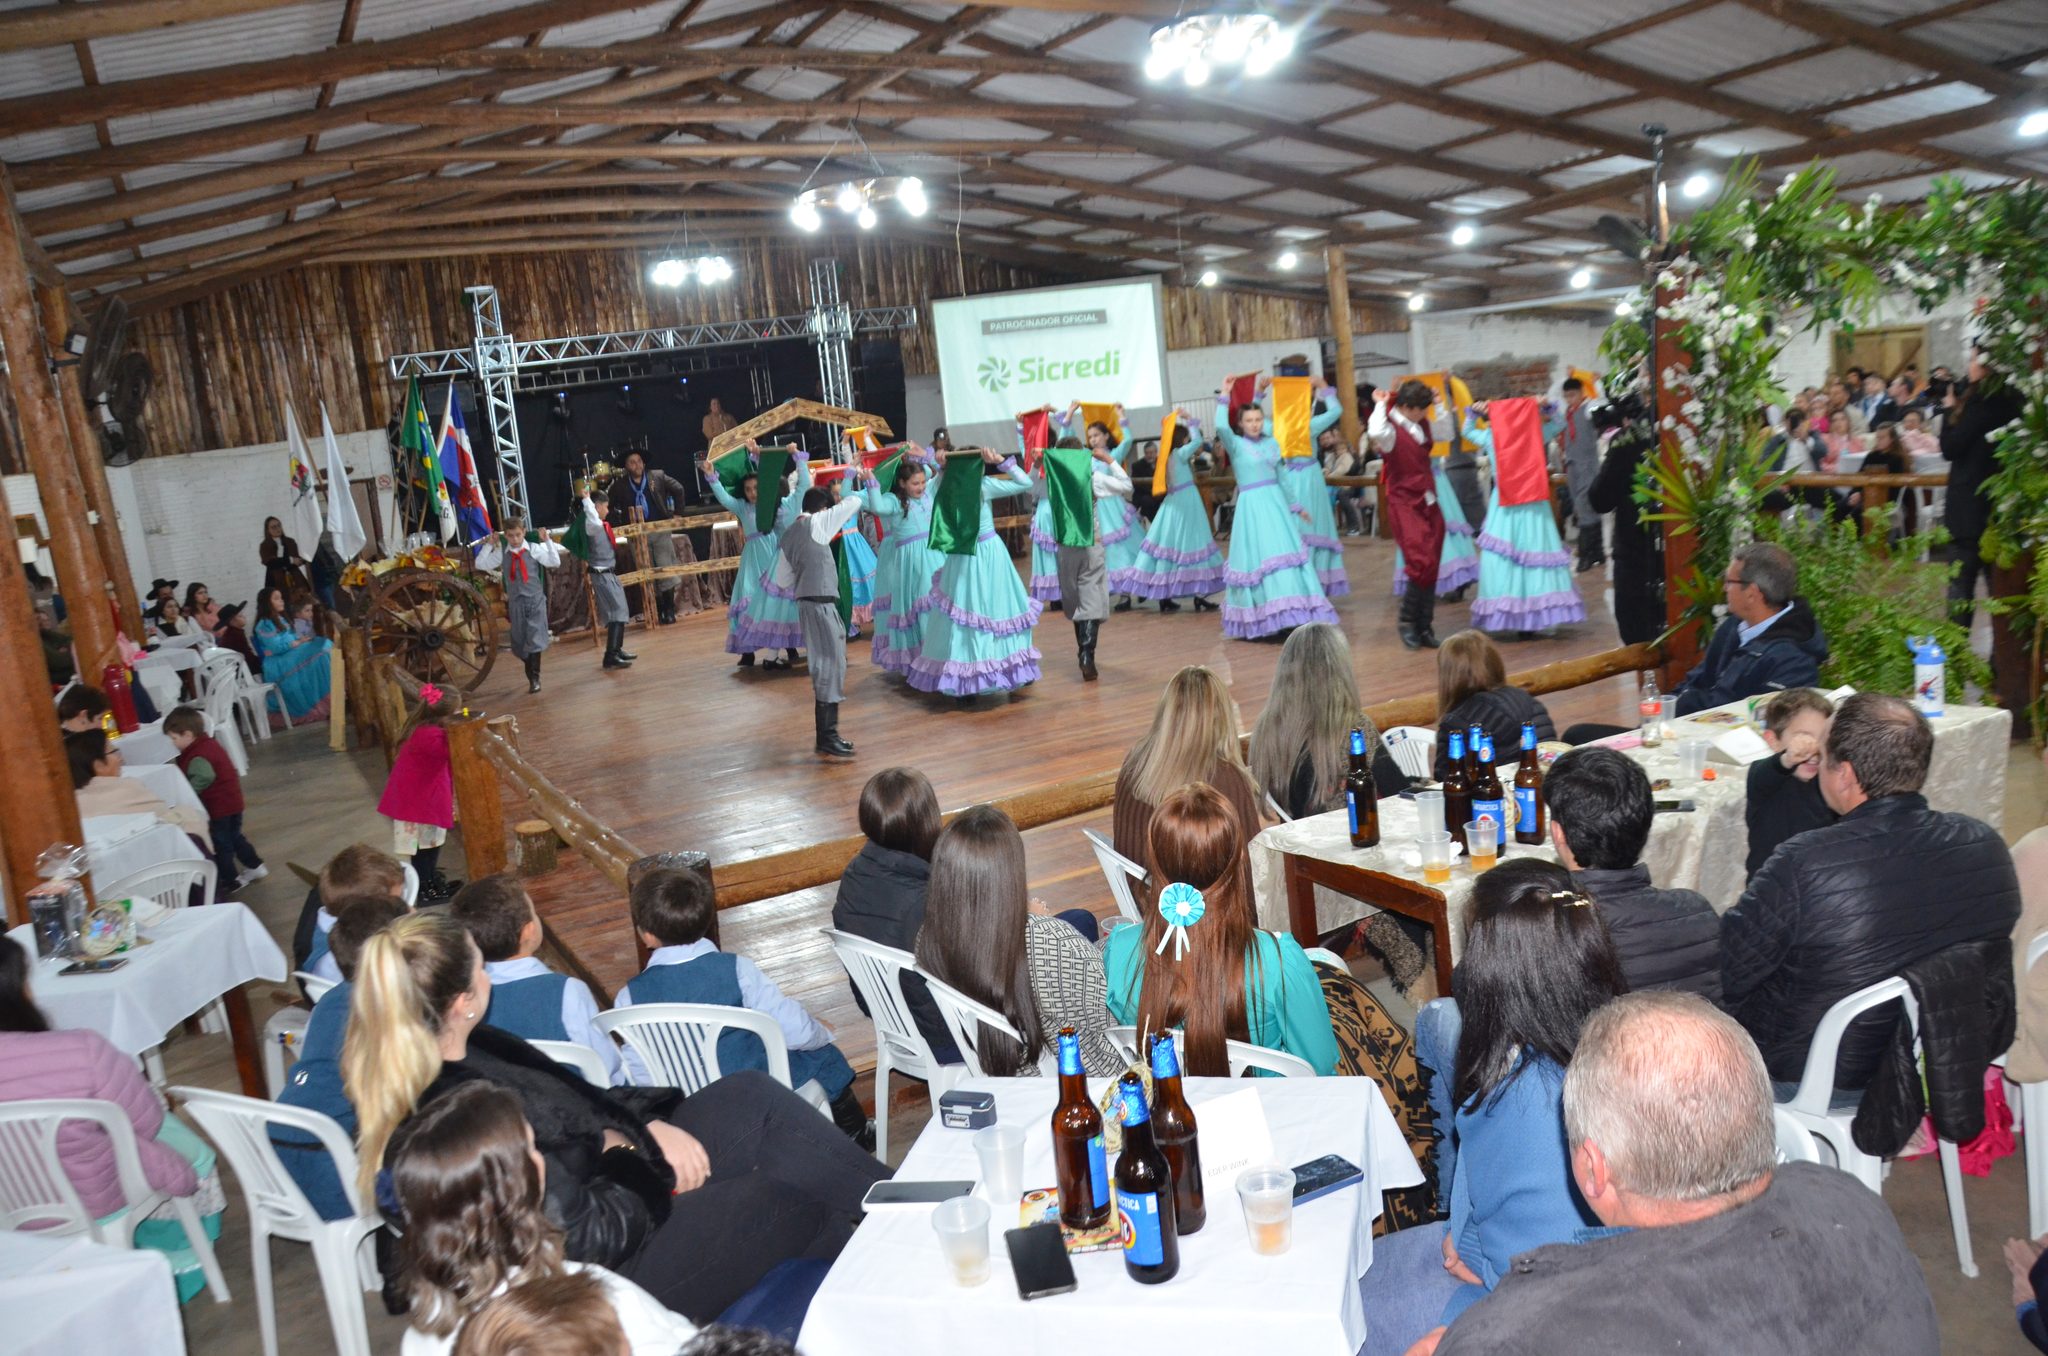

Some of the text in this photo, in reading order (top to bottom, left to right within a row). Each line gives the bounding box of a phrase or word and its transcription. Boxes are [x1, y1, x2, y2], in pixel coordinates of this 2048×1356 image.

[990, 313, 1098, 331] PATROCINADOR OFICIAL
[1019, 349, 1120, 384] Sicredi
